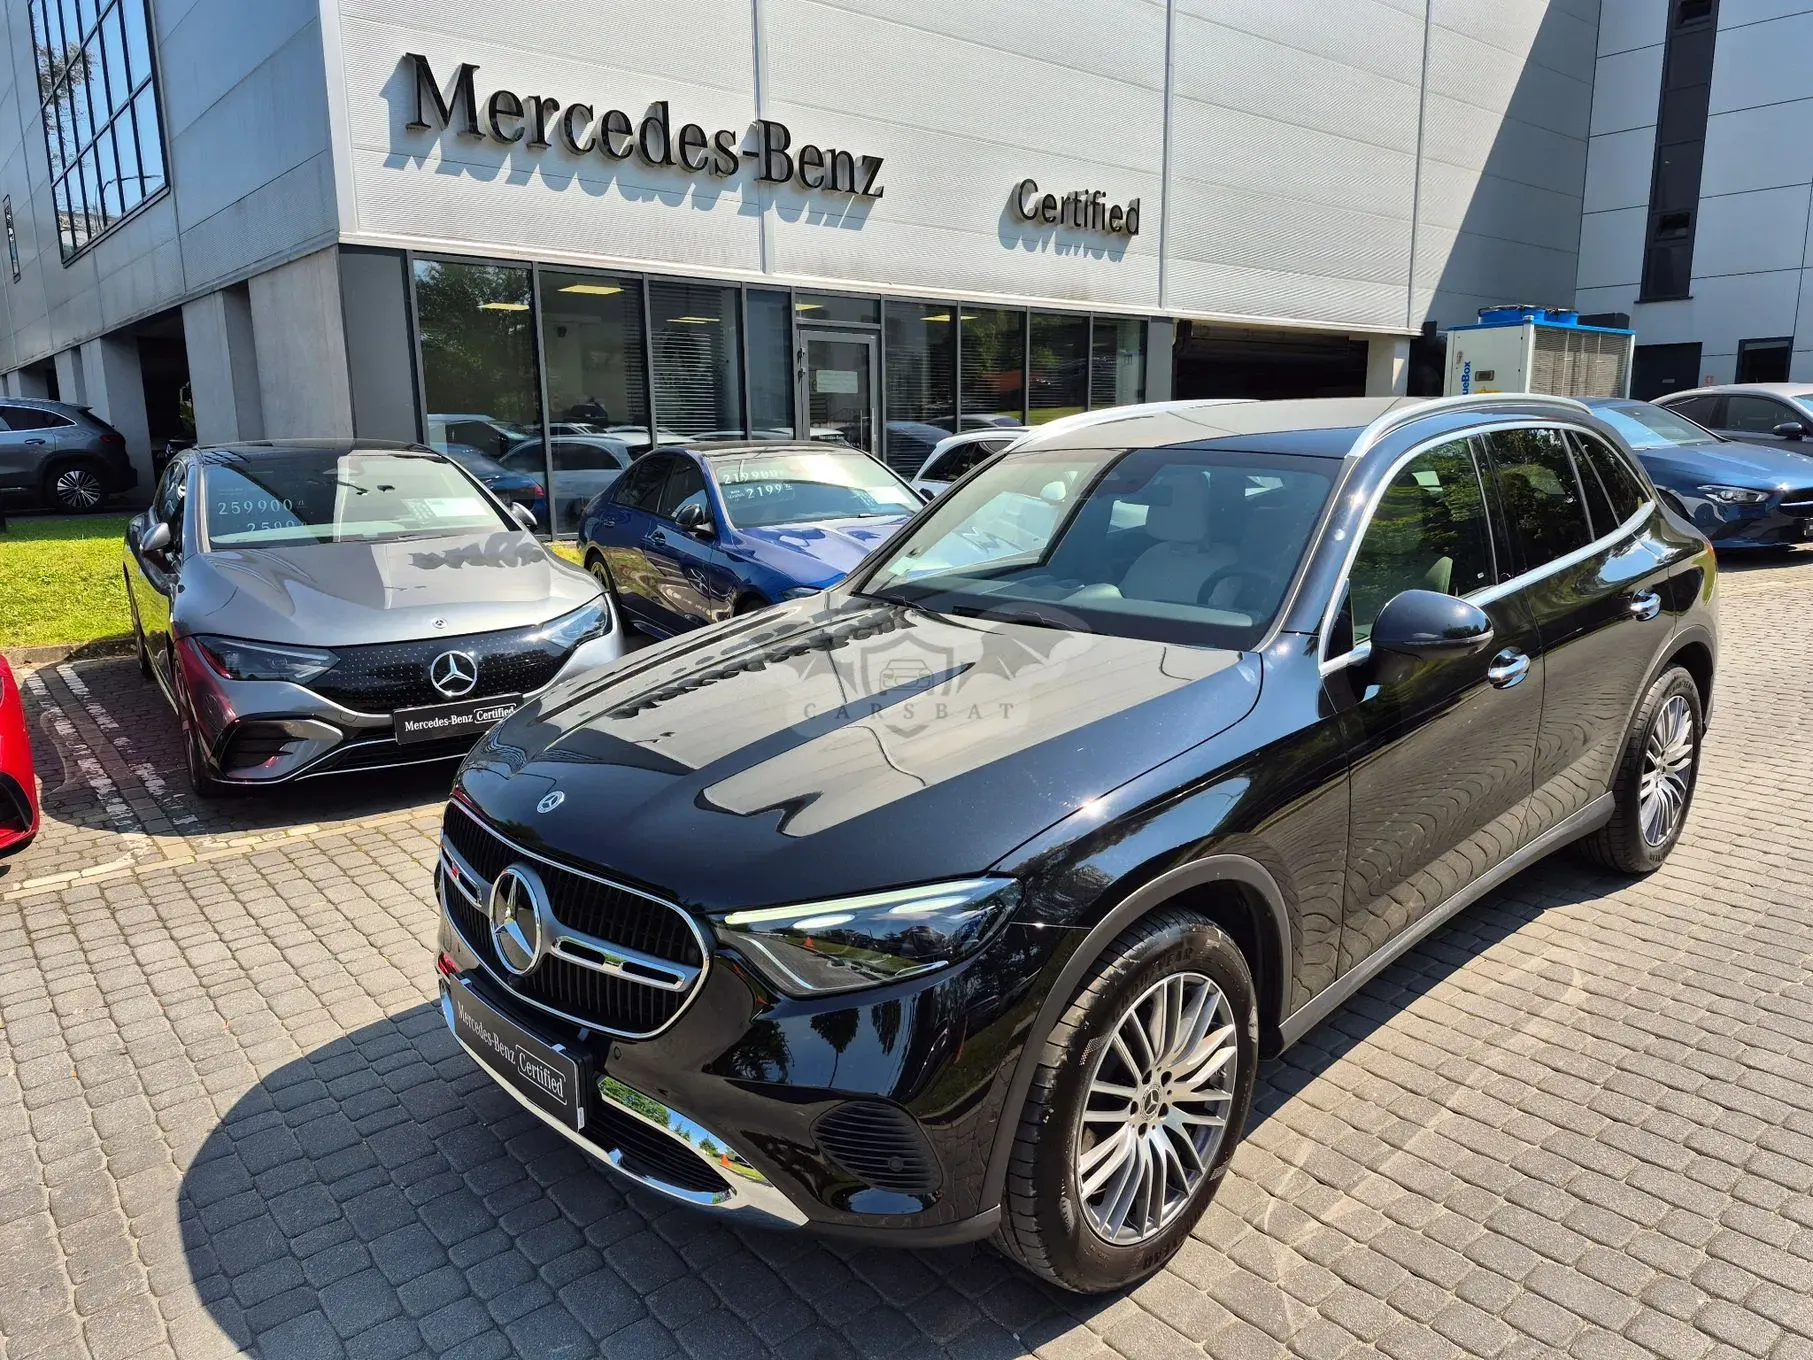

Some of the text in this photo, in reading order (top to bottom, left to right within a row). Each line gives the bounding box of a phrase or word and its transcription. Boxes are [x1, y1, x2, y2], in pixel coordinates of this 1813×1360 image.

[404, 52, 1141, 236] Mercedes-Benz Certified
[1461, 361, 1471, 395] ueBox
[746, 483, 782, 498] 2199
[218, 499, 292, 514] 259900
[404, 706, 515, 732] Mercedes-Benz Certified
[457, 1000, 564, 1098] Mercedes-Benz Certified
